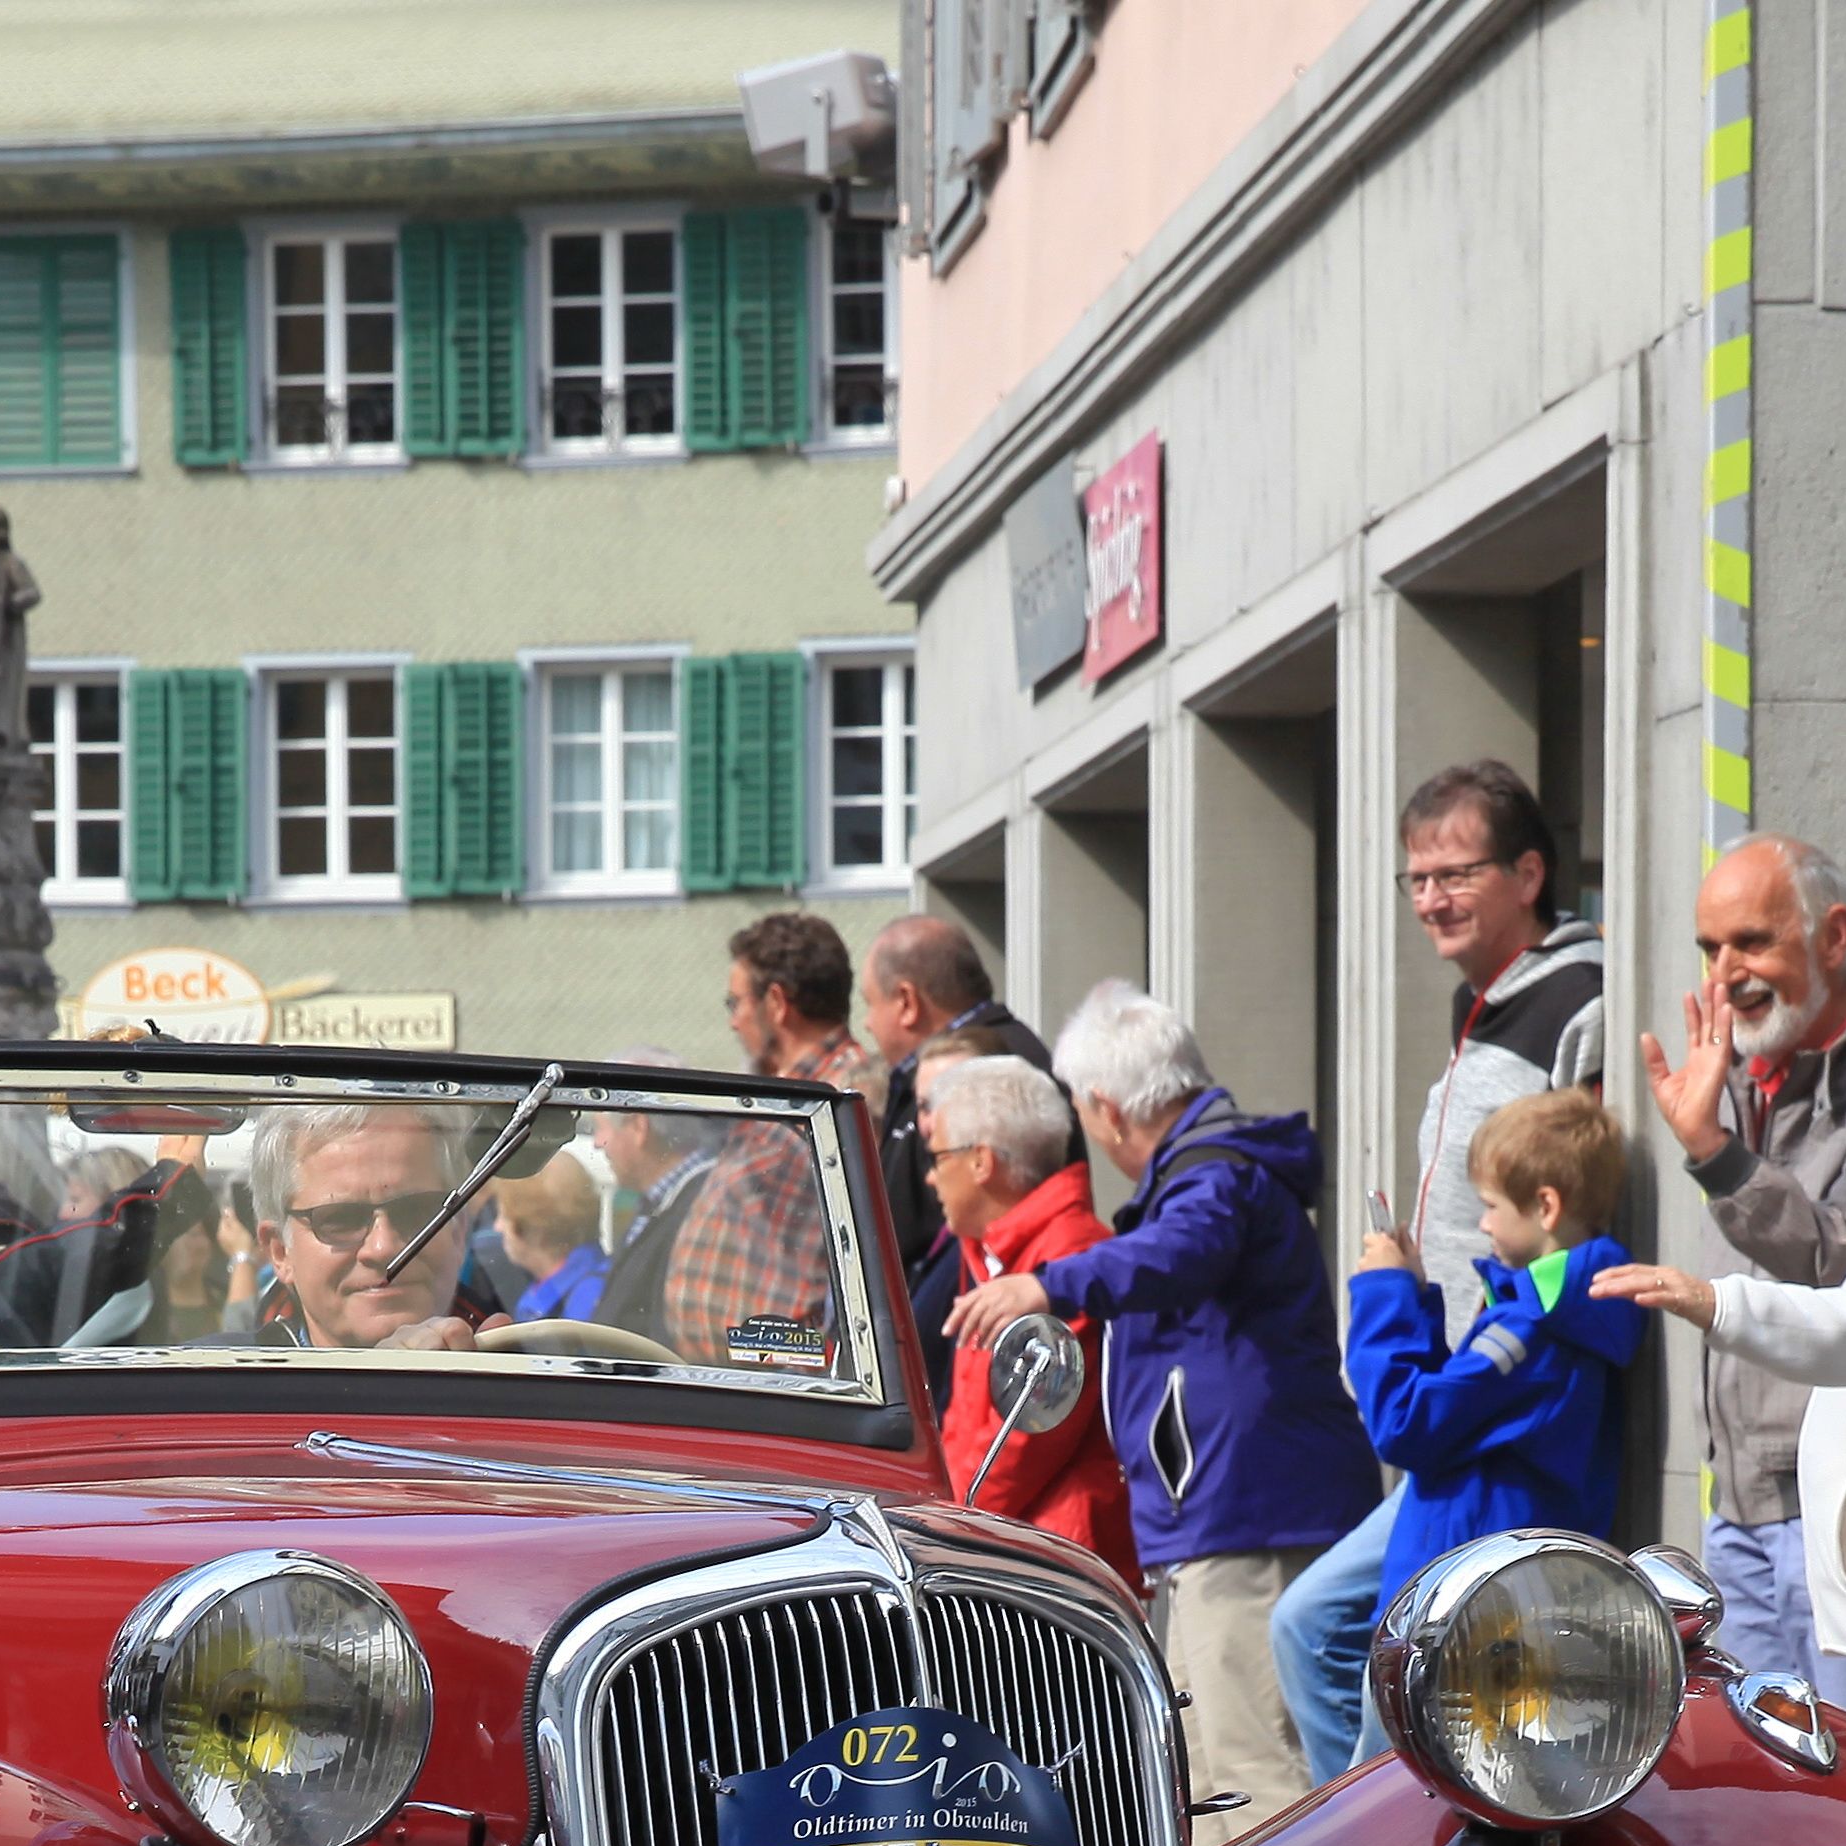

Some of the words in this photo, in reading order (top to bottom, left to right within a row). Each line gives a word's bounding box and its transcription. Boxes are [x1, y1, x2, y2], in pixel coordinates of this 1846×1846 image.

[124, 965, 230, 1002] Beck
[277, 1005, 444, 1041] Bäckerei
[784, 1331, 821, 1346] 2015
[842, 1724, 920, 1766] 072
[954, 1797, 977, 1807] 2015
[793, 1813, 899, 1838] Oldtimer
[904, 1809, 925, 1828] in
[933, 1808, 1029, 1834] Obwalden
